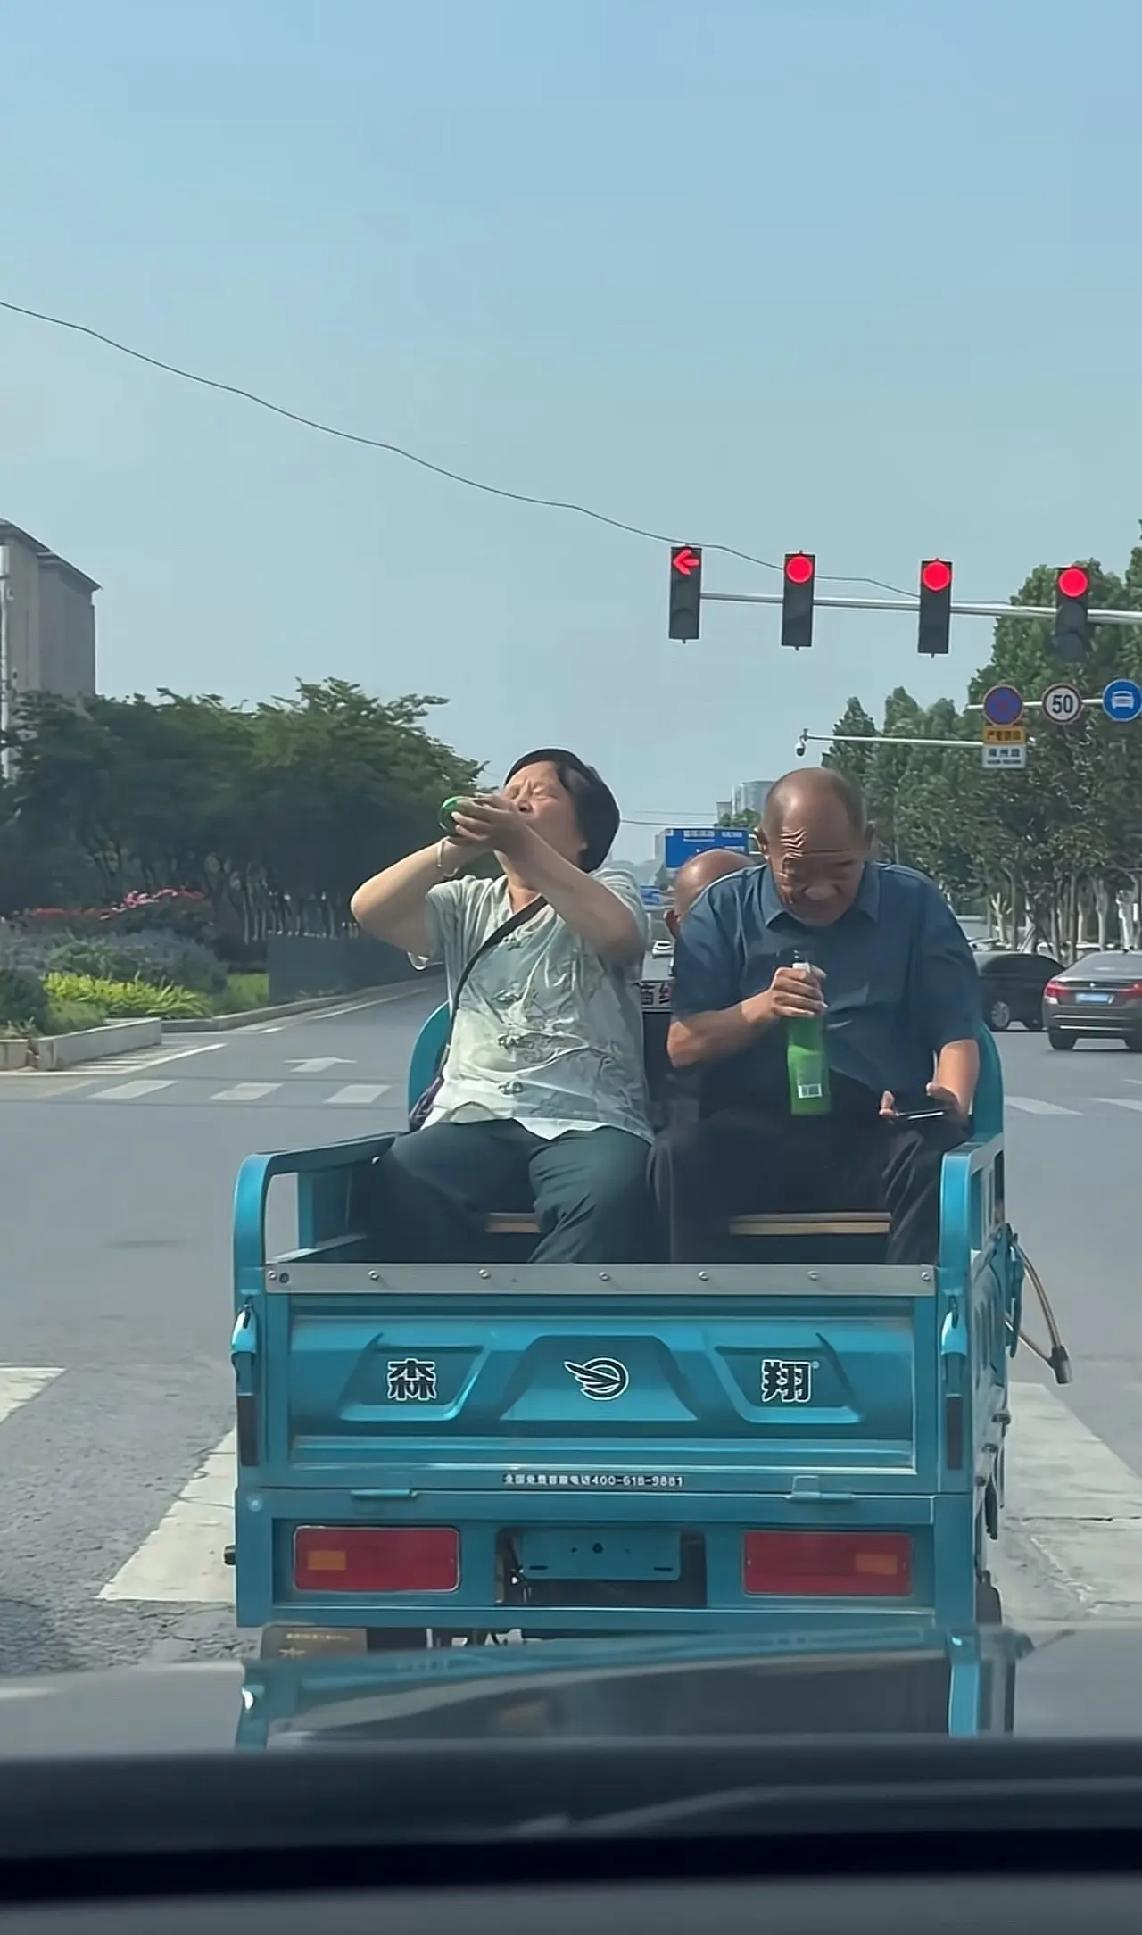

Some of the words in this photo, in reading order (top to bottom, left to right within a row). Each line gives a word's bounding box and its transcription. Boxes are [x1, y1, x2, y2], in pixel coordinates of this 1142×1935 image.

[1052, 694, 1073, 714] 50
[387, 1358, 436, 1401] 森
[762, 1359, 811, 1403] 翔
